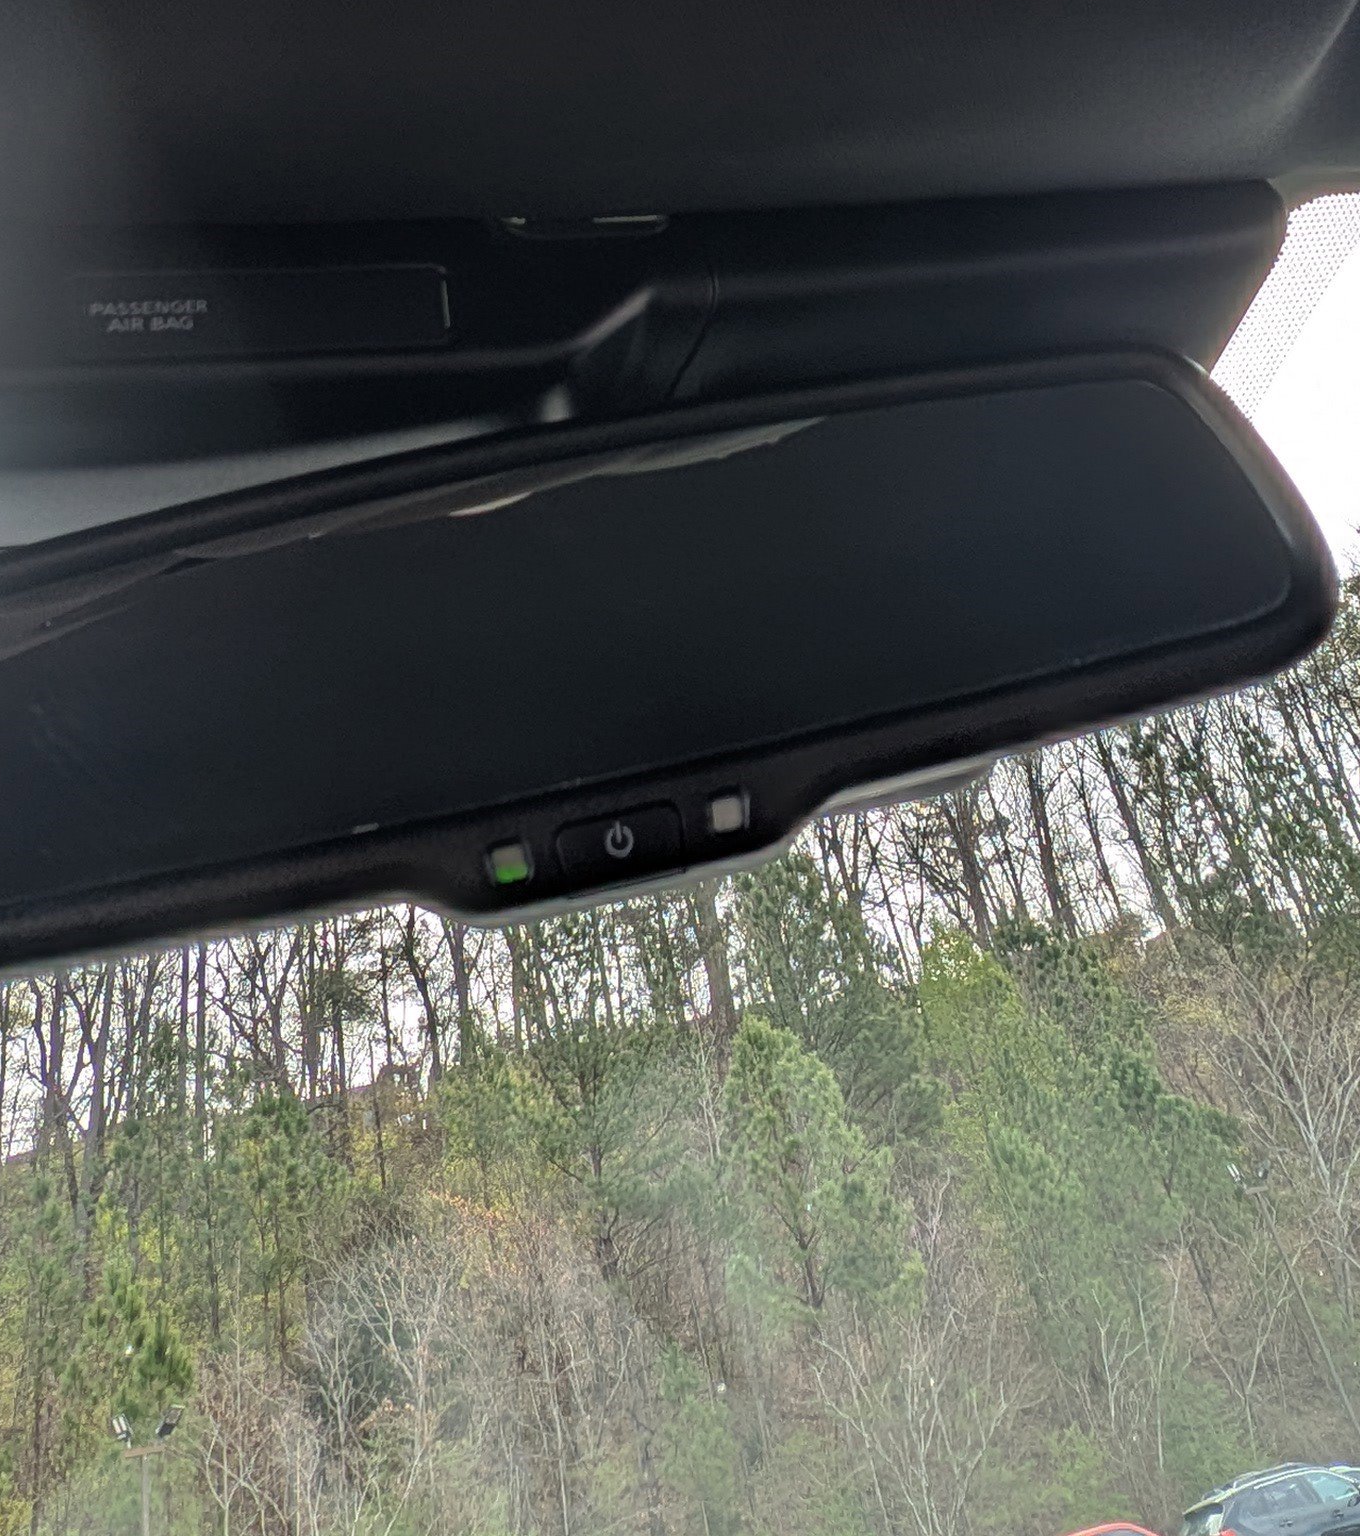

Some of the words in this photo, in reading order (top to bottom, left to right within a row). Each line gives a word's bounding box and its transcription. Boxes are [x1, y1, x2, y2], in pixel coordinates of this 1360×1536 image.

[88, 299, 208, 315] PASSENGER
[106, 317, 144, 333] AIR
[150, 316, 194, 333] BAG
